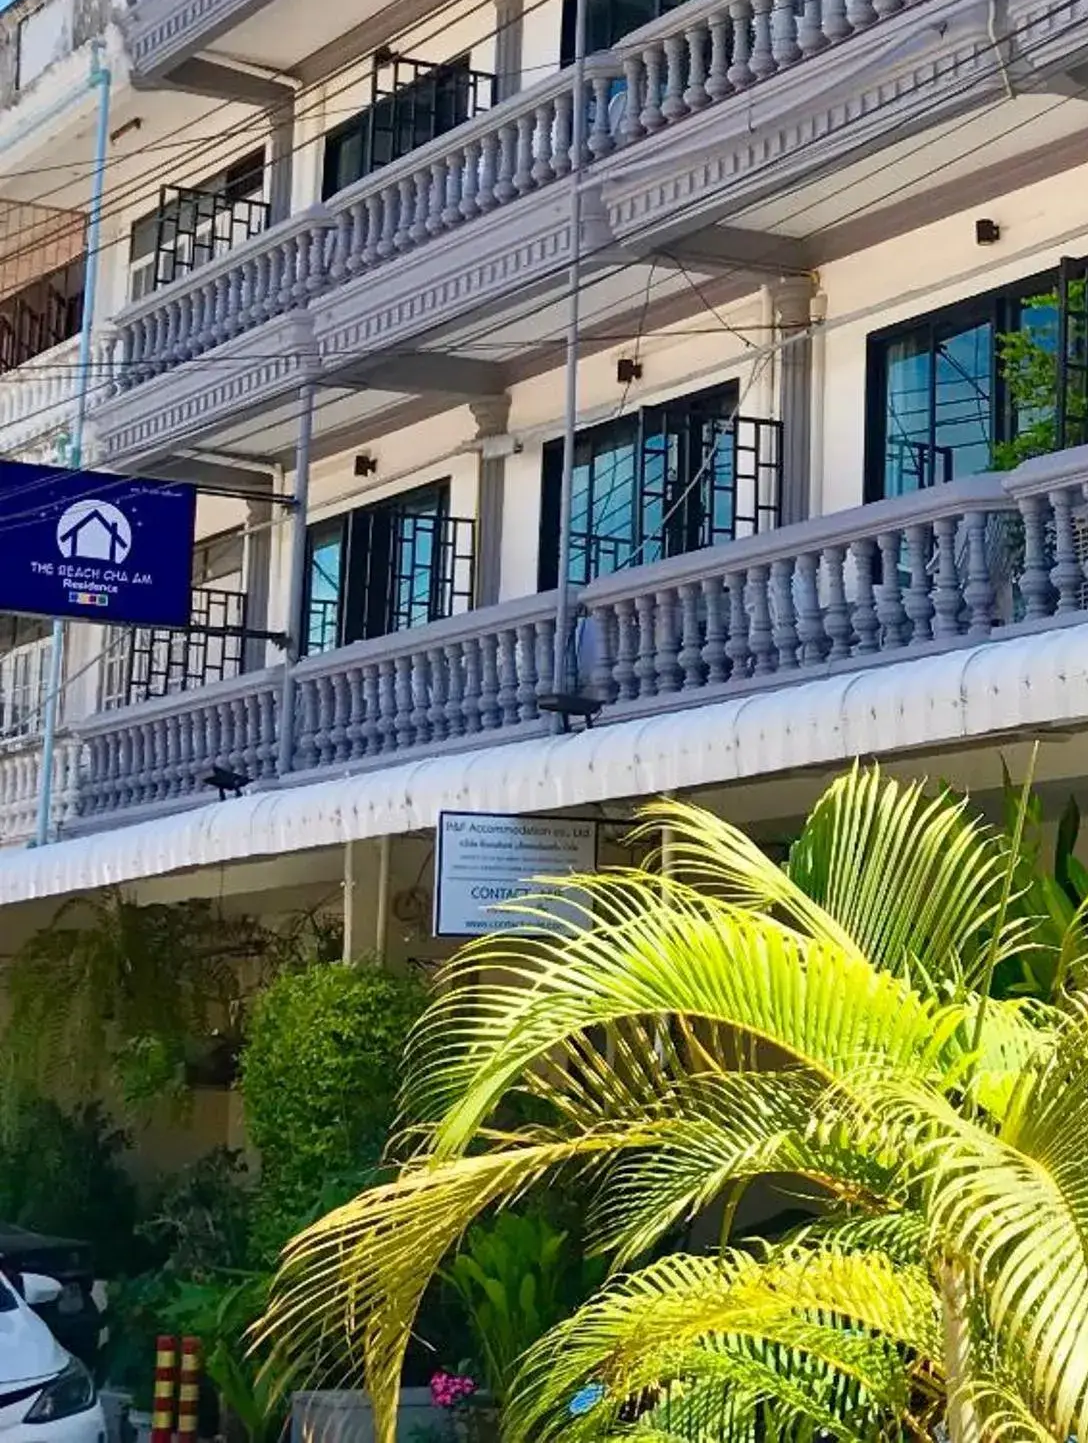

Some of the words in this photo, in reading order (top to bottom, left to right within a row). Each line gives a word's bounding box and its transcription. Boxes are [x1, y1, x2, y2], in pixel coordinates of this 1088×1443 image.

[30, 561, 55, 576] THE
[57, 564, 101, 579] BEACH
[103, 569, 128, 583] CHA
[132, 572, 153, 585] AM
[62, 578, 119, 594] Residence
[469, 823, 552, 837] Accommodation
